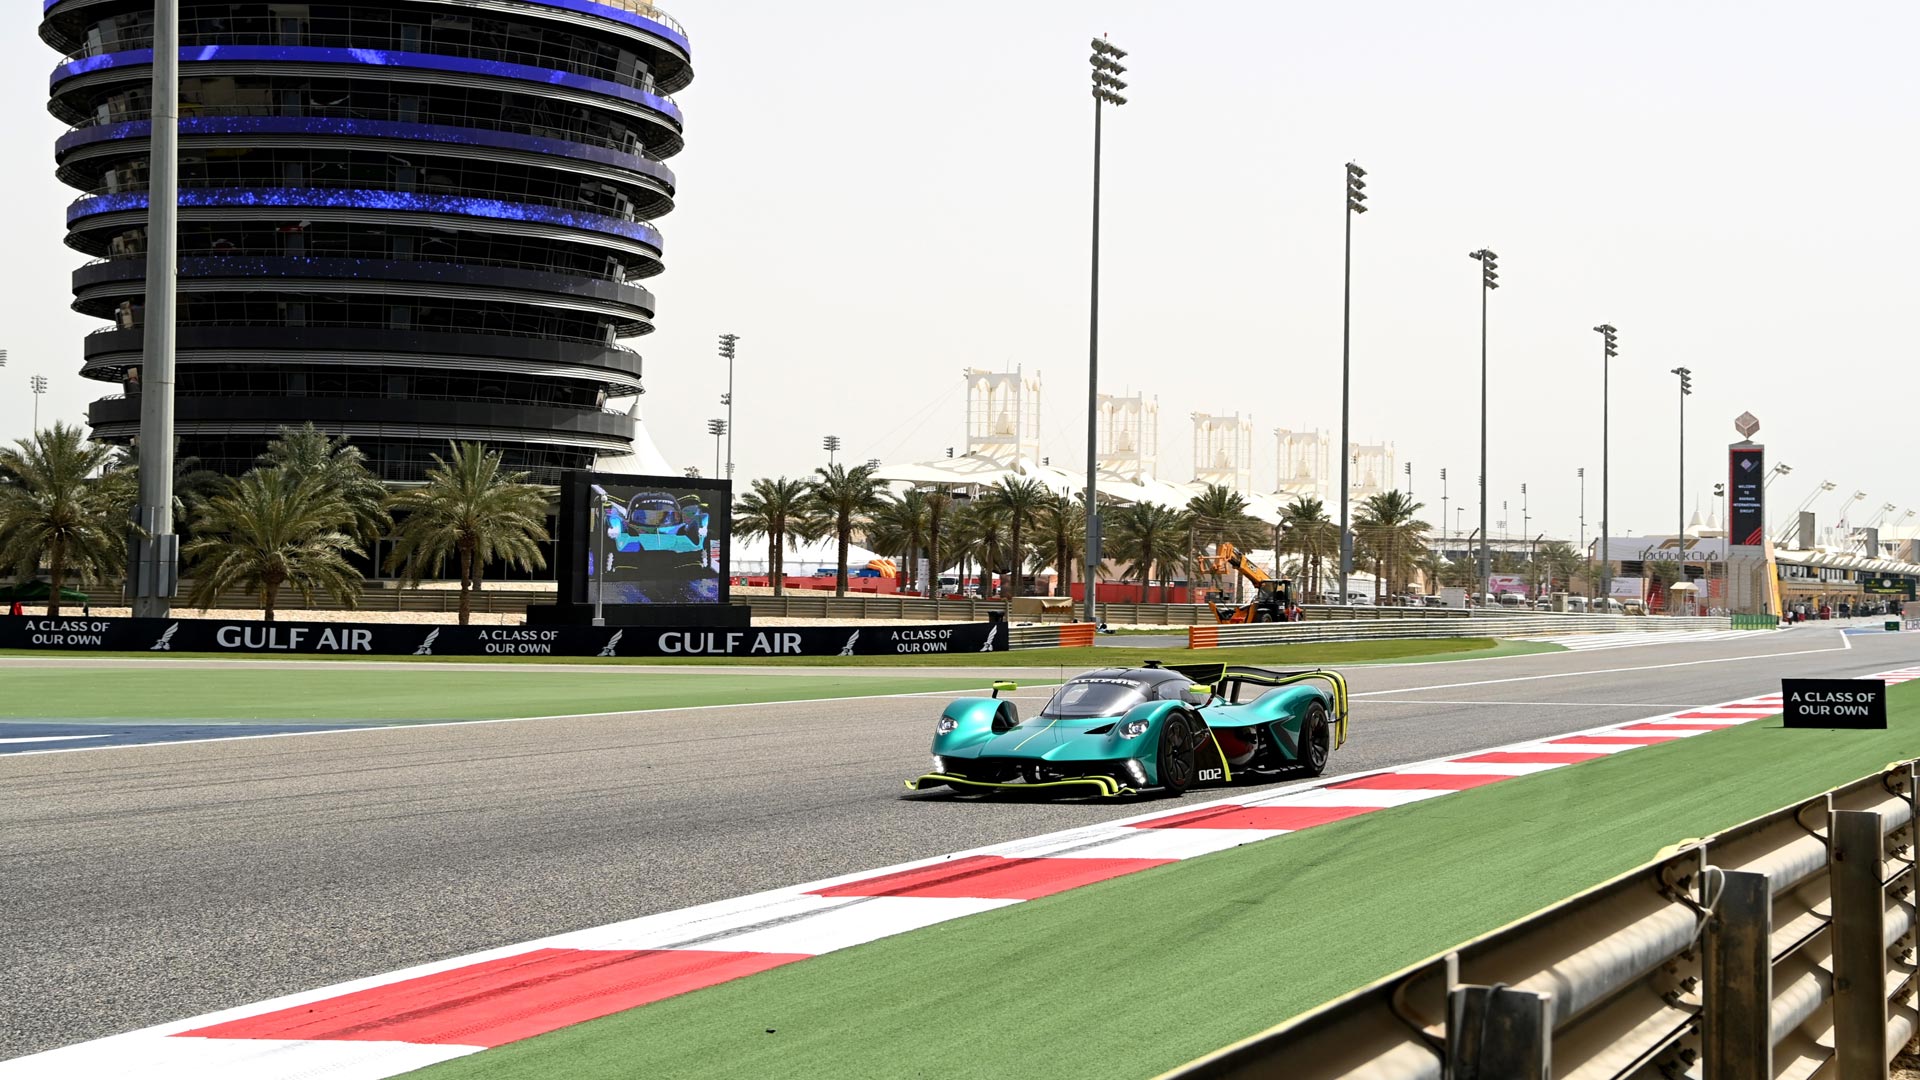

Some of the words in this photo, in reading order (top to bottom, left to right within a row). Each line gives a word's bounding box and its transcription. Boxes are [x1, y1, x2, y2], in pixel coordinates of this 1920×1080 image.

[1692, 550, 1718, 561] Club
[25, 620, 36, 631] A
[39, 620, 88, 632] CLASS
[90, 622, 111, 632] OF
[32, 633, 64, 644] OUR
[67, 634, 102, 646] OWN
[216, 625, 309, 649] GULF
[316, 627, 372, 651] AIR
[478, 629, 489, 640] A
[491, 630, 538, 641] CLASS
[540, 630, 558, 641] OF
[891, 631, 900, 640] A
[902, 630, 937, 640] CLASS
[938, 629, 953, 639] OF
[485, 643, 515, 653] OUR
[518, 643, 551, 654] OWN
[658, 631, 744, 654] GULF
[750, 631, 802, 654] AIR
[896, 642, 921, 653] OUR
[923, 642, 947, 652] OWN
[1790, 691, 1802, 702] A
[1804, 691, 1854, 703] CLASS
[1856, 692, 1876, 703] OF
[1798, 704, 1830, 716] OUR
[1833, 705, 1869, 716] OWN
[1198, 768, 1222, 781] 002
